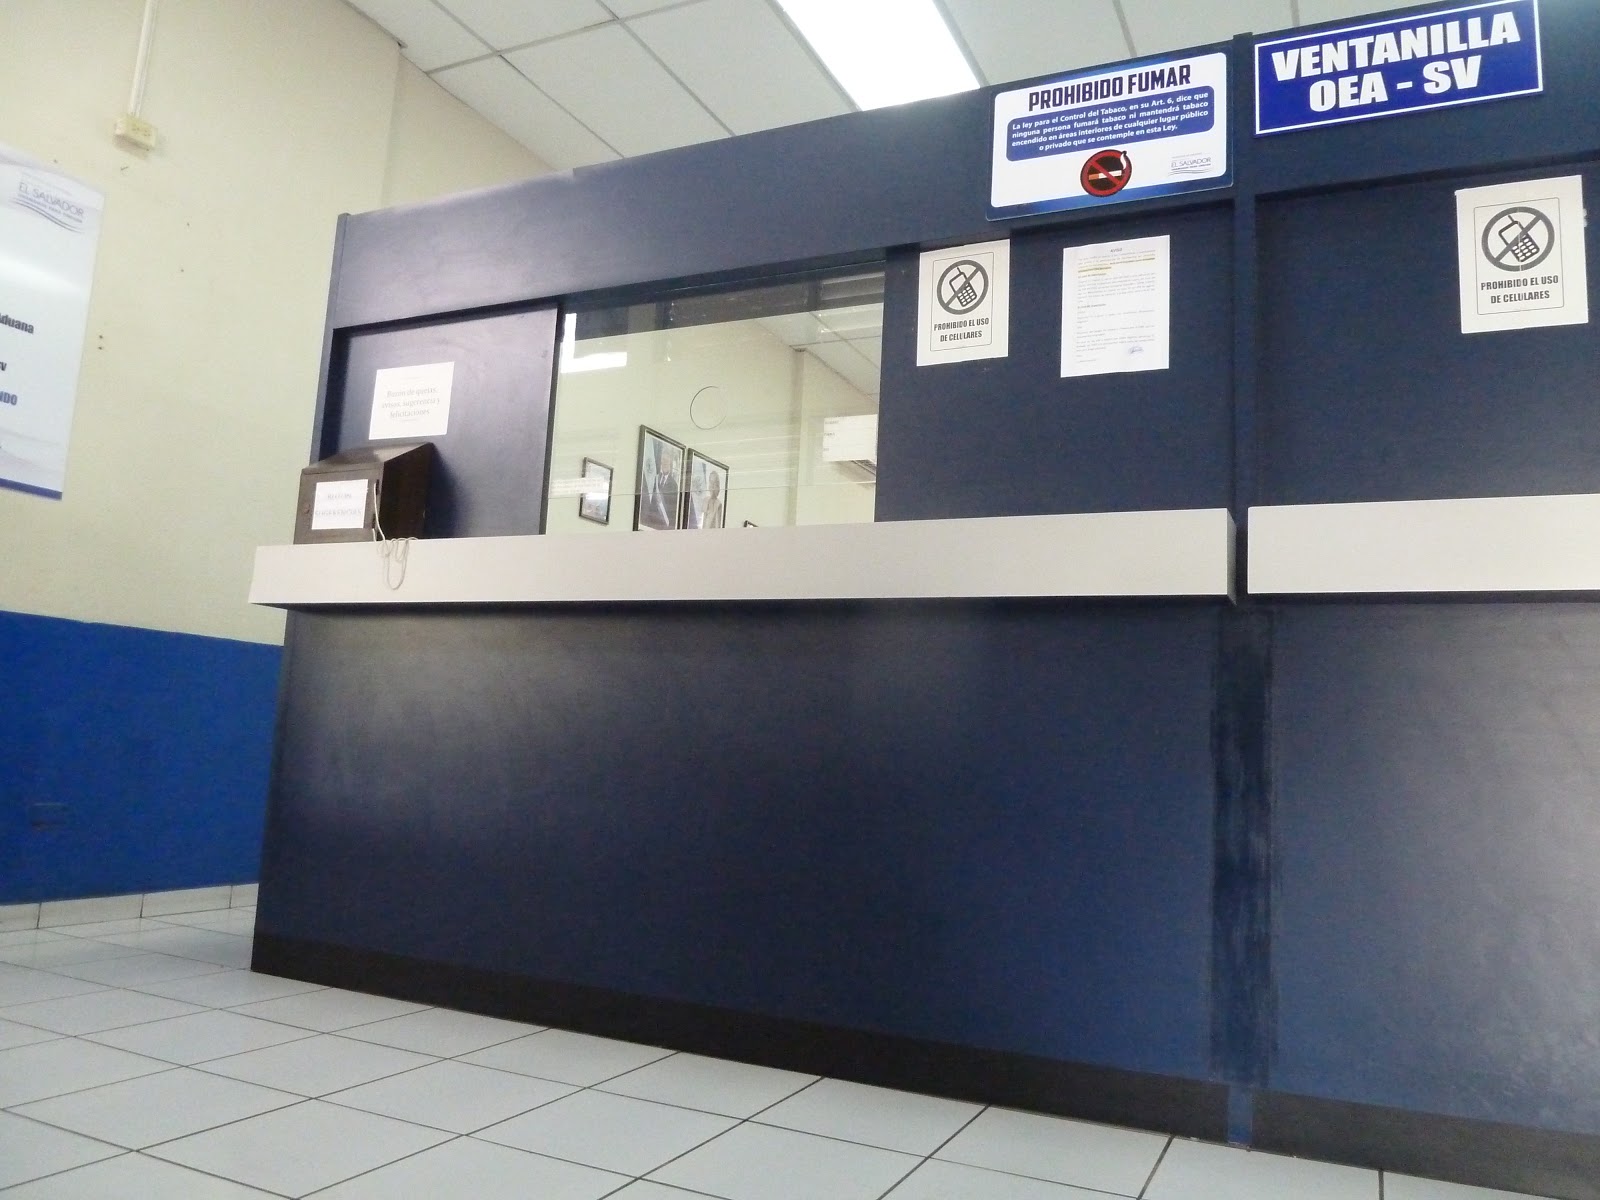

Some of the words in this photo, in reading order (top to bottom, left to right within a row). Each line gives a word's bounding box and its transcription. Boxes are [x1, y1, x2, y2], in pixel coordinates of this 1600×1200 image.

[1271, 11, 1521, 82] VENTANILLA
[1028, 76, 1124, 112] PROHIBIDO
[1127, 64, 1191, 95] FUMAR
[1309, 71, 1388, 112] OEA
[1396, 81, 1413, 90] -
[1422, 55, 1482, 94] SV
[1012, 129, 1041, 139] ninguna
[1042, 124, 1071, 134] persona
[1073, 118, 1099, 128] fumará
[1101, 114, 1127, 124] tabaco
[1129, 111, 1137, 119] ni
[1139, 104, 1180, 117] mantendrá
[1182, 101, 1209, 110] tabaco
[1022, 121, 1033, 129] ley
[1034, 118, 1050, 128] para
[1051, 116, 1059, 124] el
[1060, 111, 1086, 122] Control
[1087, 109, 1099, 117] del
[1101, 106, 1128, 115] Tabaco,
[1129, 103, 1139, 111] en
[1151, 99, 1165, 107] Art.
[1176, 95, 1192, 103] dice
[1193, 92, 1209, 101] que
[1011, 135, 1048, 147] encendido
[1058, 130, 1077, 139] áreas
[1078, 124, 1113, 136] interiores
[1124, 117, 1159, 129] cualquier
[1159, 114, 1179, 124] lugar
[1180, 110, 1209, 121] público
[1045, 140, 1072, 151] privado
[1072, 138, 1087, 146] que
[1096, 130, 1135, 142] contemple
[1135, 128, 1145, 136] en
[1146, 126, 1162, 134] esta
[1180, 157, 1211, 167] SALVADOR
[33, 188, 84, 217] SALVADOR
[1480, 278, 1528, 291] PROHIBIDO
[1530, 277, 1539, 286] EL
[1541, 275, 1559, 285] USO
[1490, 295, 1502, 304] DE
[1503, 290, 1550, 303] CELULARES
[933, 320, 968, 331] PROHIBIDO
[968, 319, 976, 327] EL
[976, 317, 990, 326] USO
[940, 334, 948, 342] DE
[949, 330, 983, 341] CELULARES
